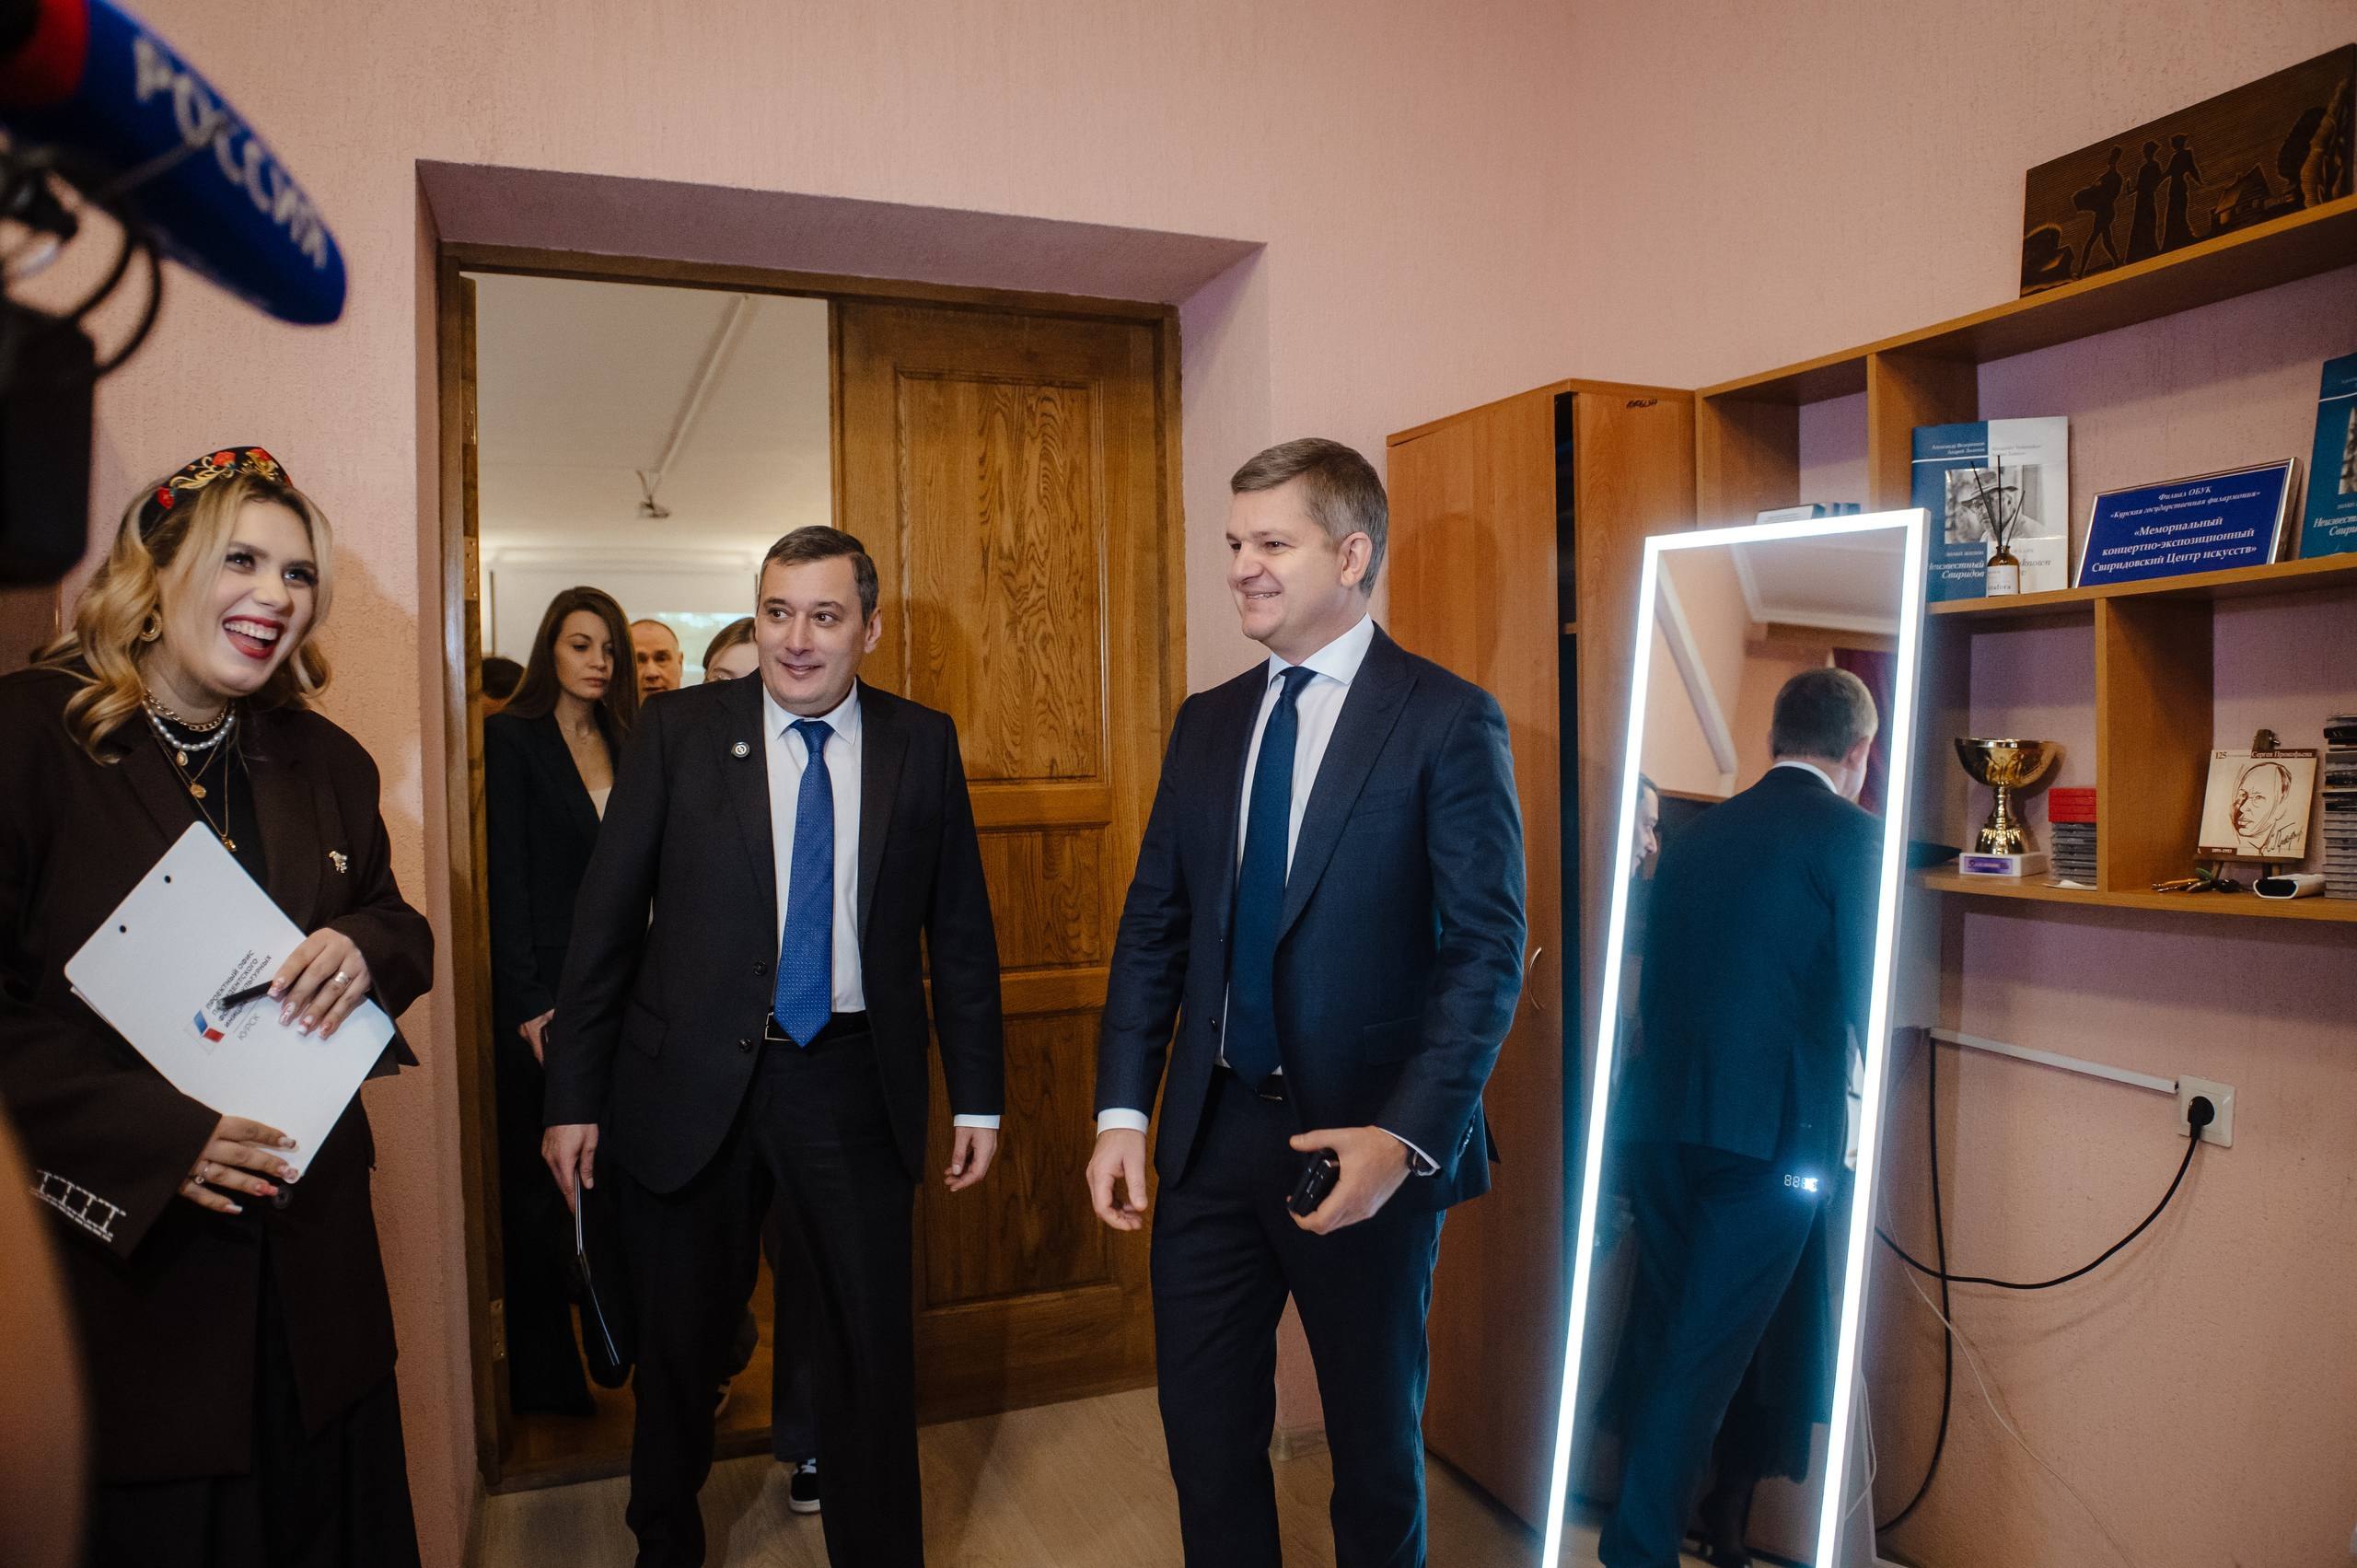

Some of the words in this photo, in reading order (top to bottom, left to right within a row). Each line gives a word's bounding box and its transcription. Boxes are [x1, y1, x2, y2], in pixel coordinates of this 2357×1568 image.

[2158, 493, 2187, 501] Филиал
[2189, 486, 2212, 496] ОБУК
[2134, 517, 2223, 536] «Мемориальный
[2102, 528, 2255, 556] концертно-экспозиционный
[2092, 555, 2165, 573] Свиридовский
[2166, 552, 2200, 563] Центр
[2202, 546, 2258, 560] искусств»
[1942, 569, 1985, 580] Свиридов
[206, 969, 238, 1009] ПРОЕКТНЫЙ
[238, 950, 255, 970] ОФИС
[241, 955, 272, 991] ЛЬТУРНЫХ
[238, 1014, 261, 1040] КУРСК
